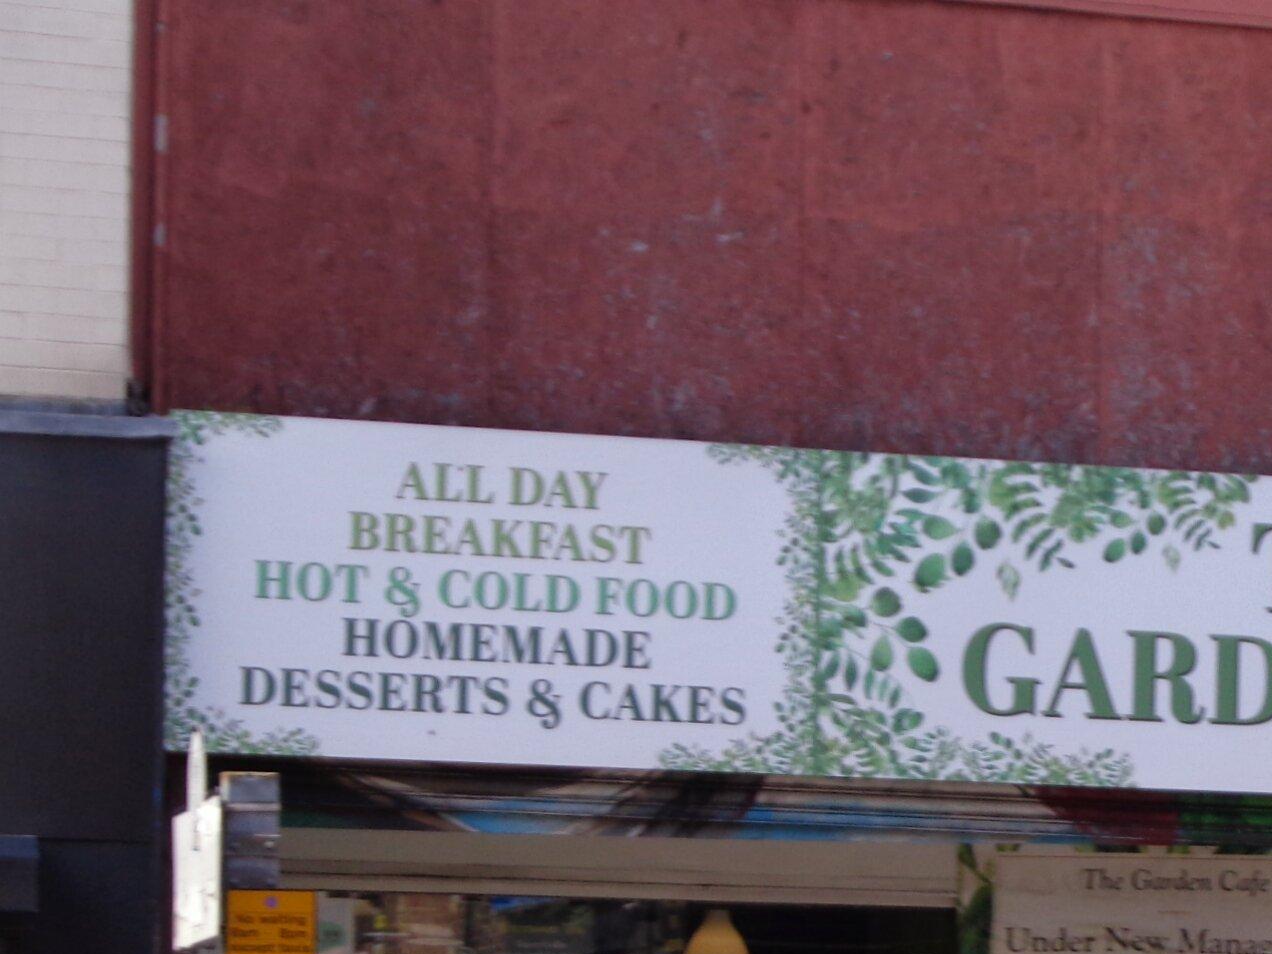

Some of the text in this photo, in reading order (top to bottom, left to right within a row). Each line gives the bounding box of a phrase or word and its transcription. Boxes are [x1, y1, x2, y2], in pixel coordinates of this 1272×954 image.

[396, 461, 609, 511] ALL DAY
[348, 510, 651, 565] BREAKFAST
[254, 559, 738, 621] HOT & COLD FOOD
[342, 617, 651, 670] HOMEMADE
[238, 666, 746, 730] DESSERTS & CAKES
[1082, 867, 1271, 896] The Garden Cafe
[1005, 926, 1095, 954] Under
[1103, 927, 1169, 953] New
